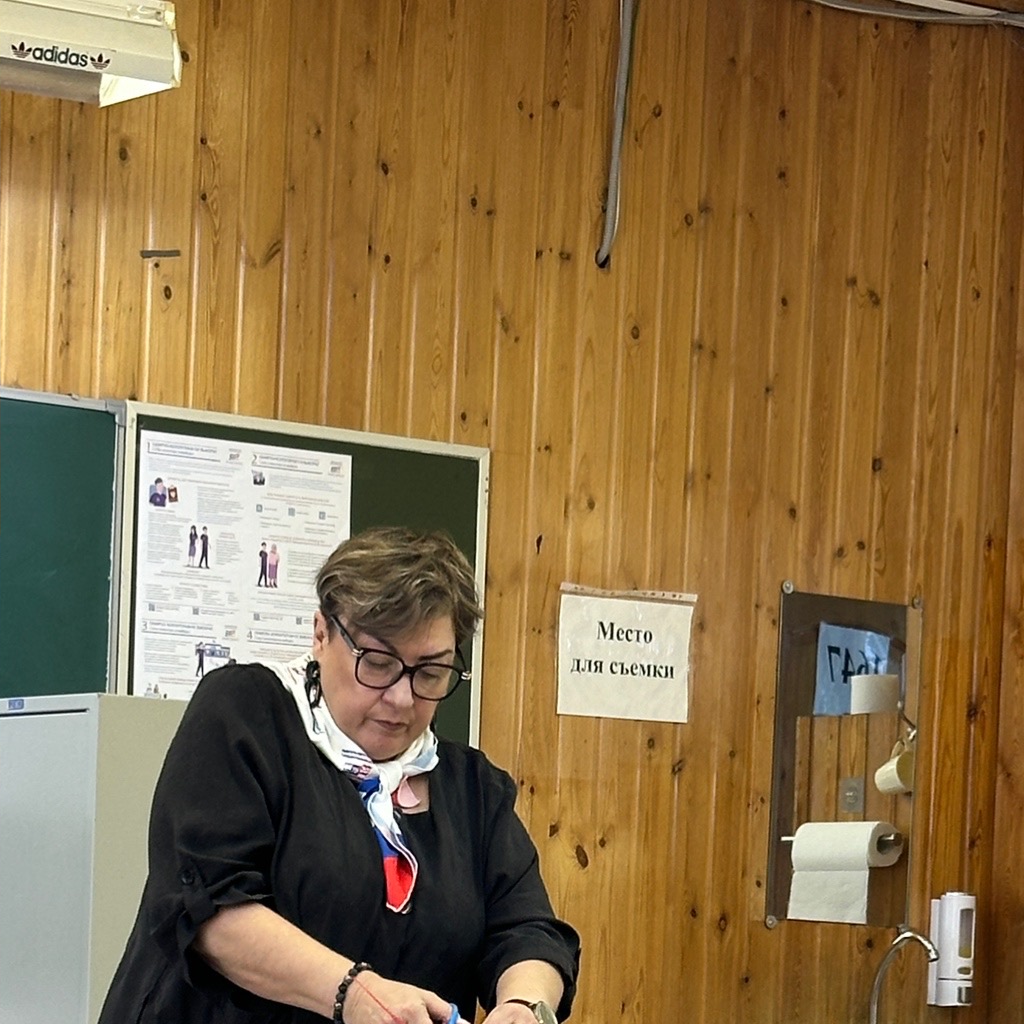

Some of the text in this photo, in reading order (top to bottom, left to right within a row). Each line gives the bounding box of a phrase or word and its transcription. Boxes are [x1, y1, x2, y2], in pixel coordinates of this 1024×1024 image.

[32, 46, 88, 67] adidas
[597, 621, 653, 644] Место
[571, 658, 675, 679] для съемки
